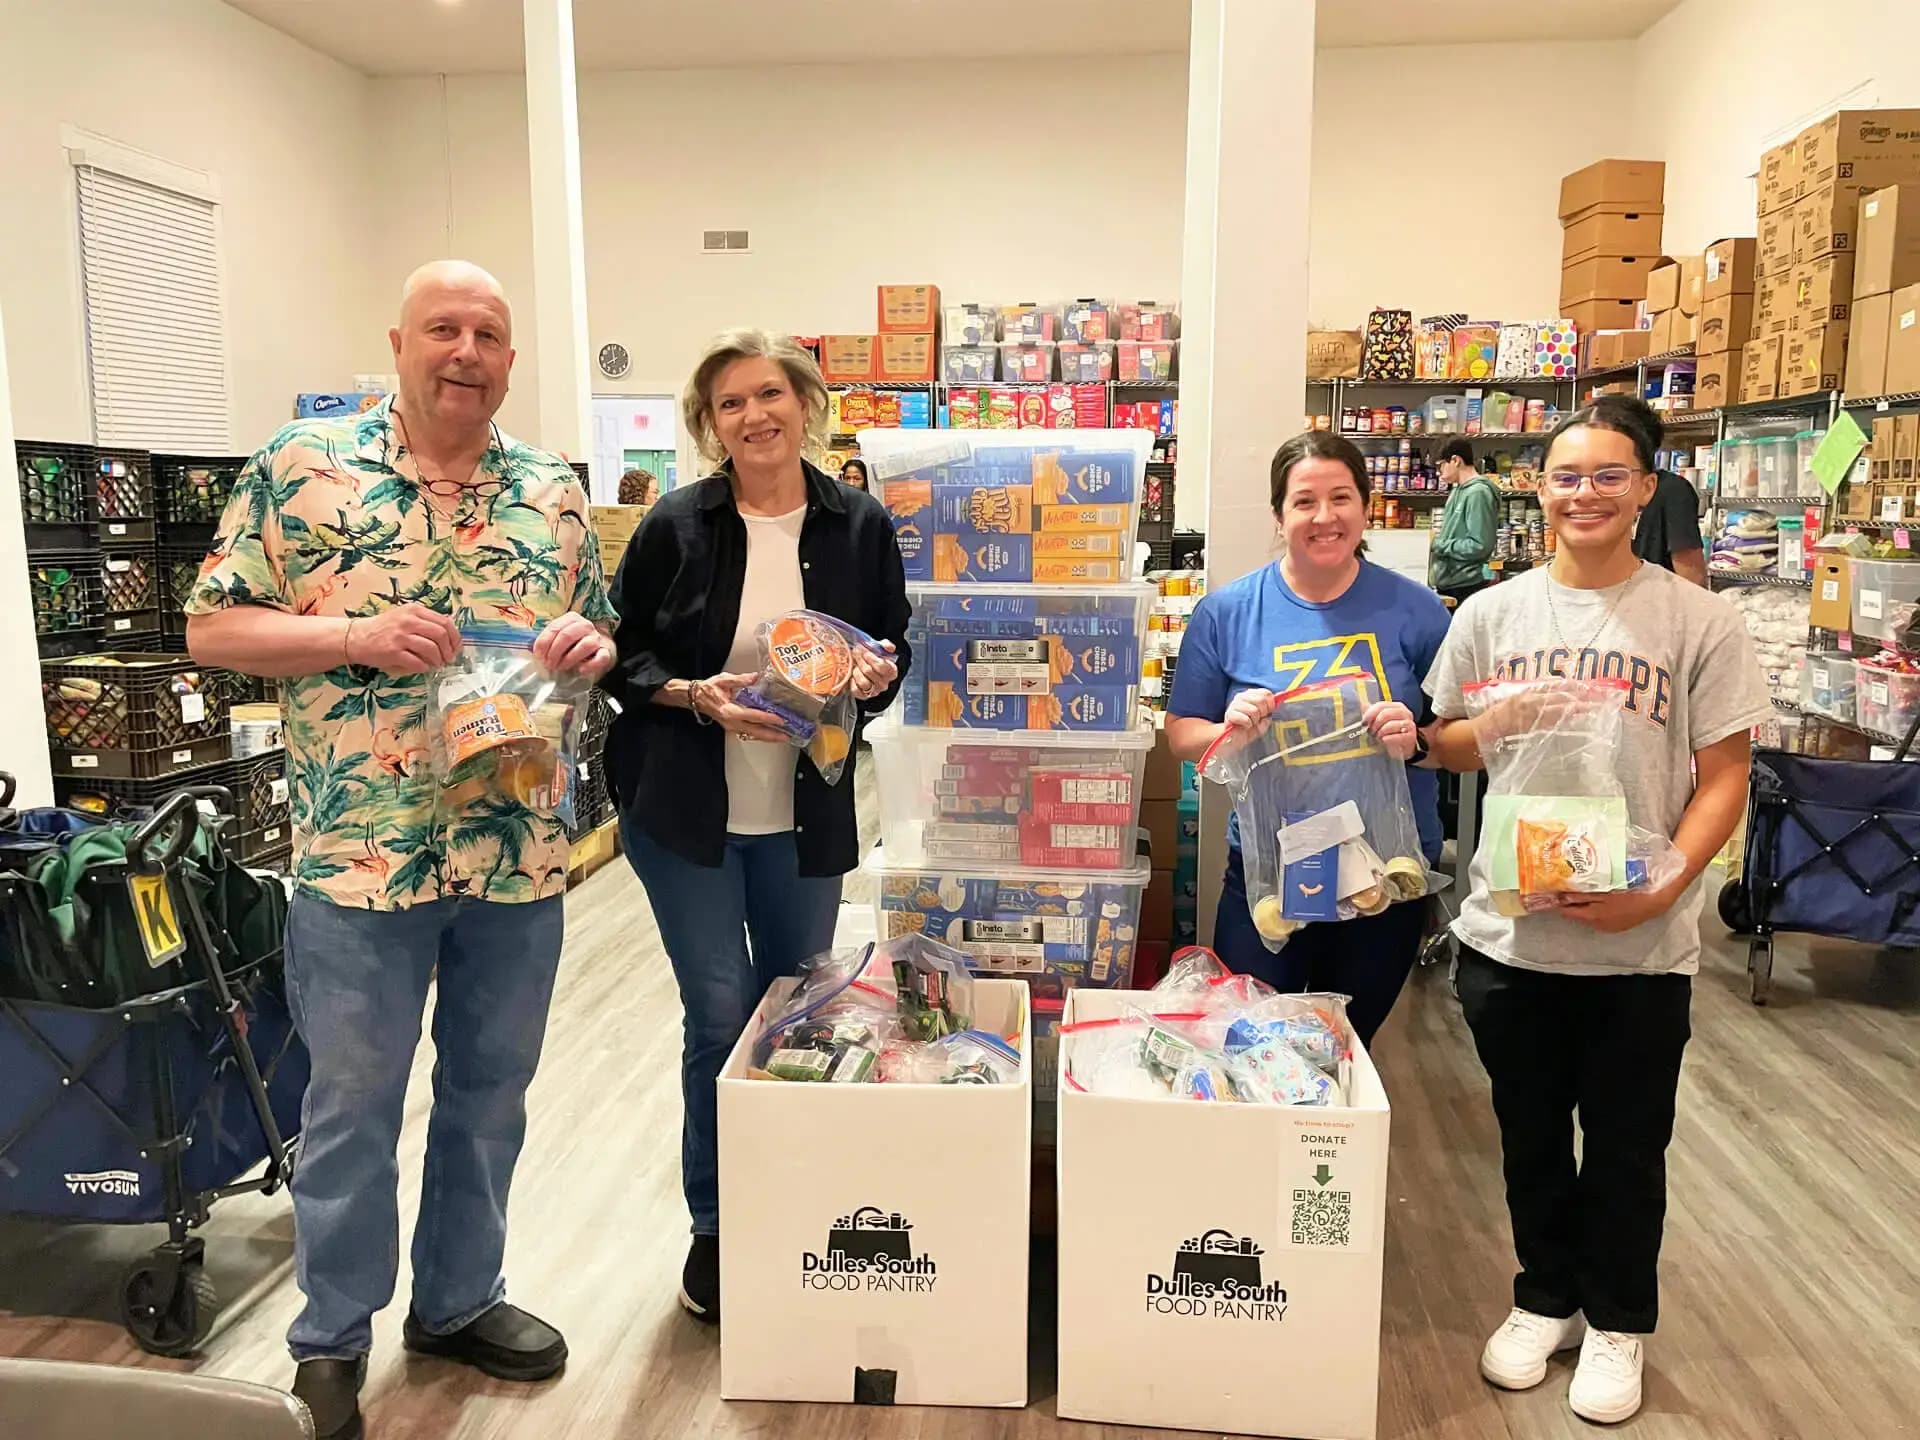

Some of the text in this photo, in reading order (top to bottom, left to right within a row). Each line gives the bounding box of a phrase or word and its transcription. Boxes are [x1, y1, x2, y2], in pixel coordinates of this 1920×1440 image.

[1839, 164, 1853, 178] FS
[1834, 235, 1847, 248] FS
[1833, 306, 1846, 319] FS
[1824, 375, 1836, 388] FS
[775, 643, 799, 657] Top
[987, 644, 1008, 652] Insta
[781, 645, 825, 667] Ramen
[453, 714, 501, 738] Ramen
[475, 723, 506, 738] Top
[141, 883, 177, 951] K
[982, 924, 1003, 933] Insta
[1301, 1134, 1347, 1145] DONATE
[1309, 1149, 1337, 1158] HERE
[65, 1180, 140, 1196] VIVOSUN
[802, 1250, 936, 1274] Dulles South
[802, 1273, 937, 1292] FOOD PANTRY
[1147, 1273, 1287, 1303] Dulles South
[1146, 1296, 1288, 1322] FOOD PANTRY
